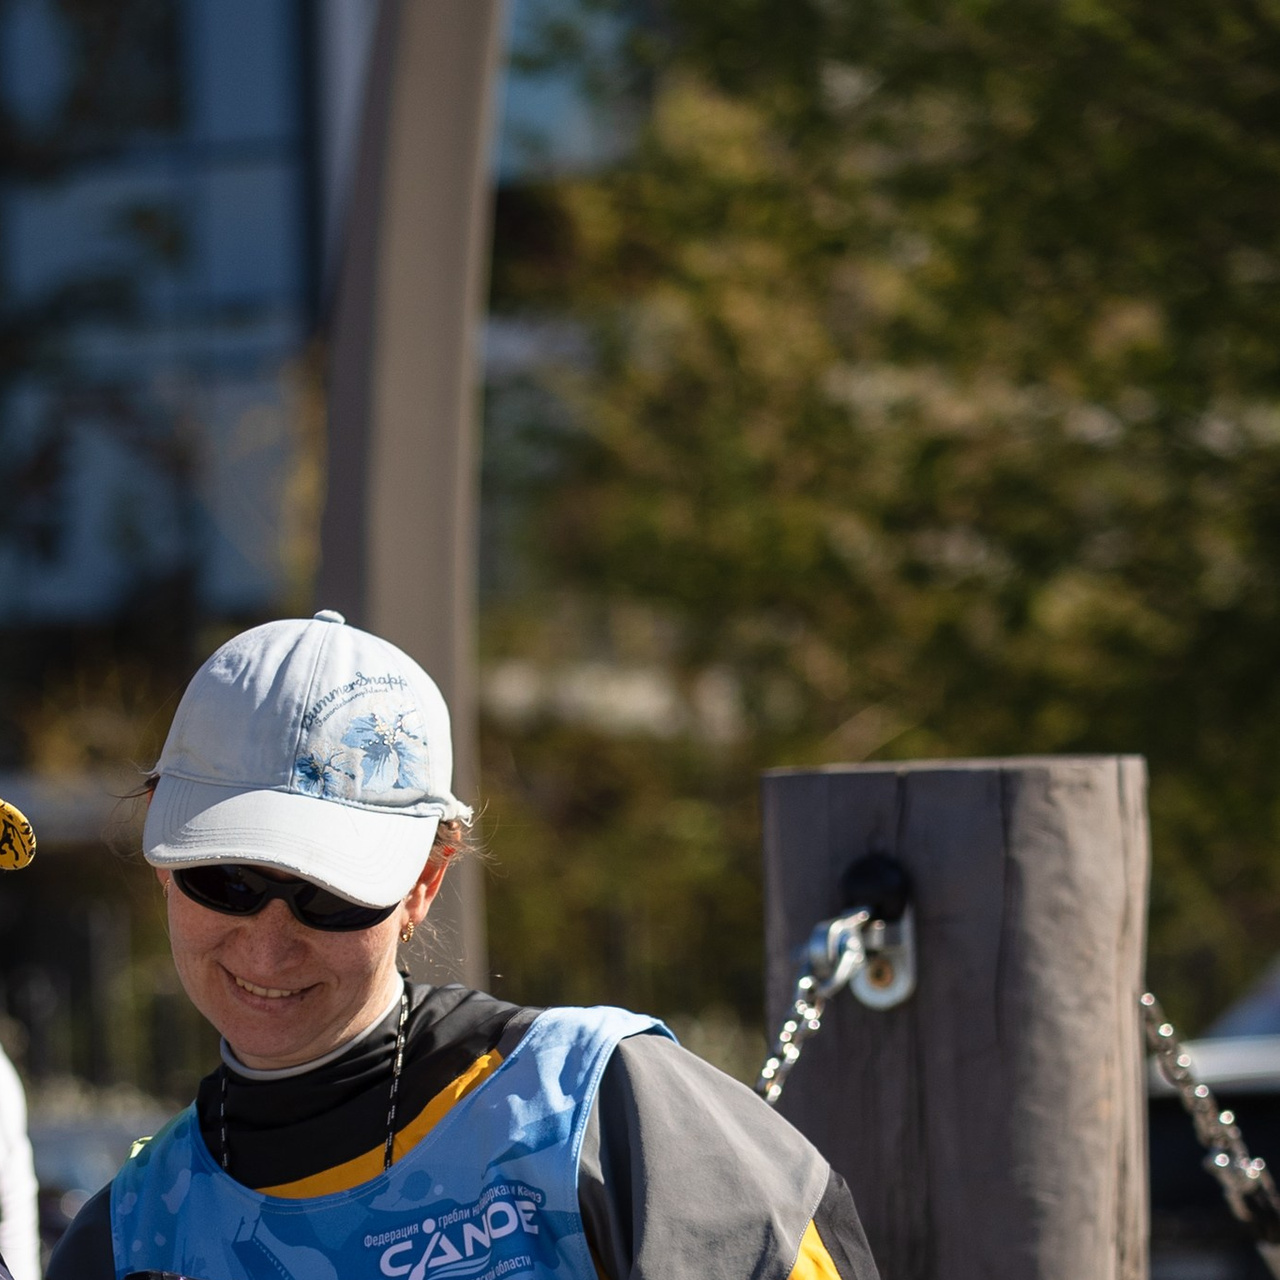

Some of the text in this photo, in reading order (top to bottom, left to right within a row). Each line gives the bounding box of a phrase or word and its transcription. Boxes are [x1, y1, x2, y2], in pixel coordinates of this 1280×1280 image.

[363, 1222, 419, 1248] Федерация
[437, 1207, 471, 1229] гребли
[495, 1254, 532, 1278] области
